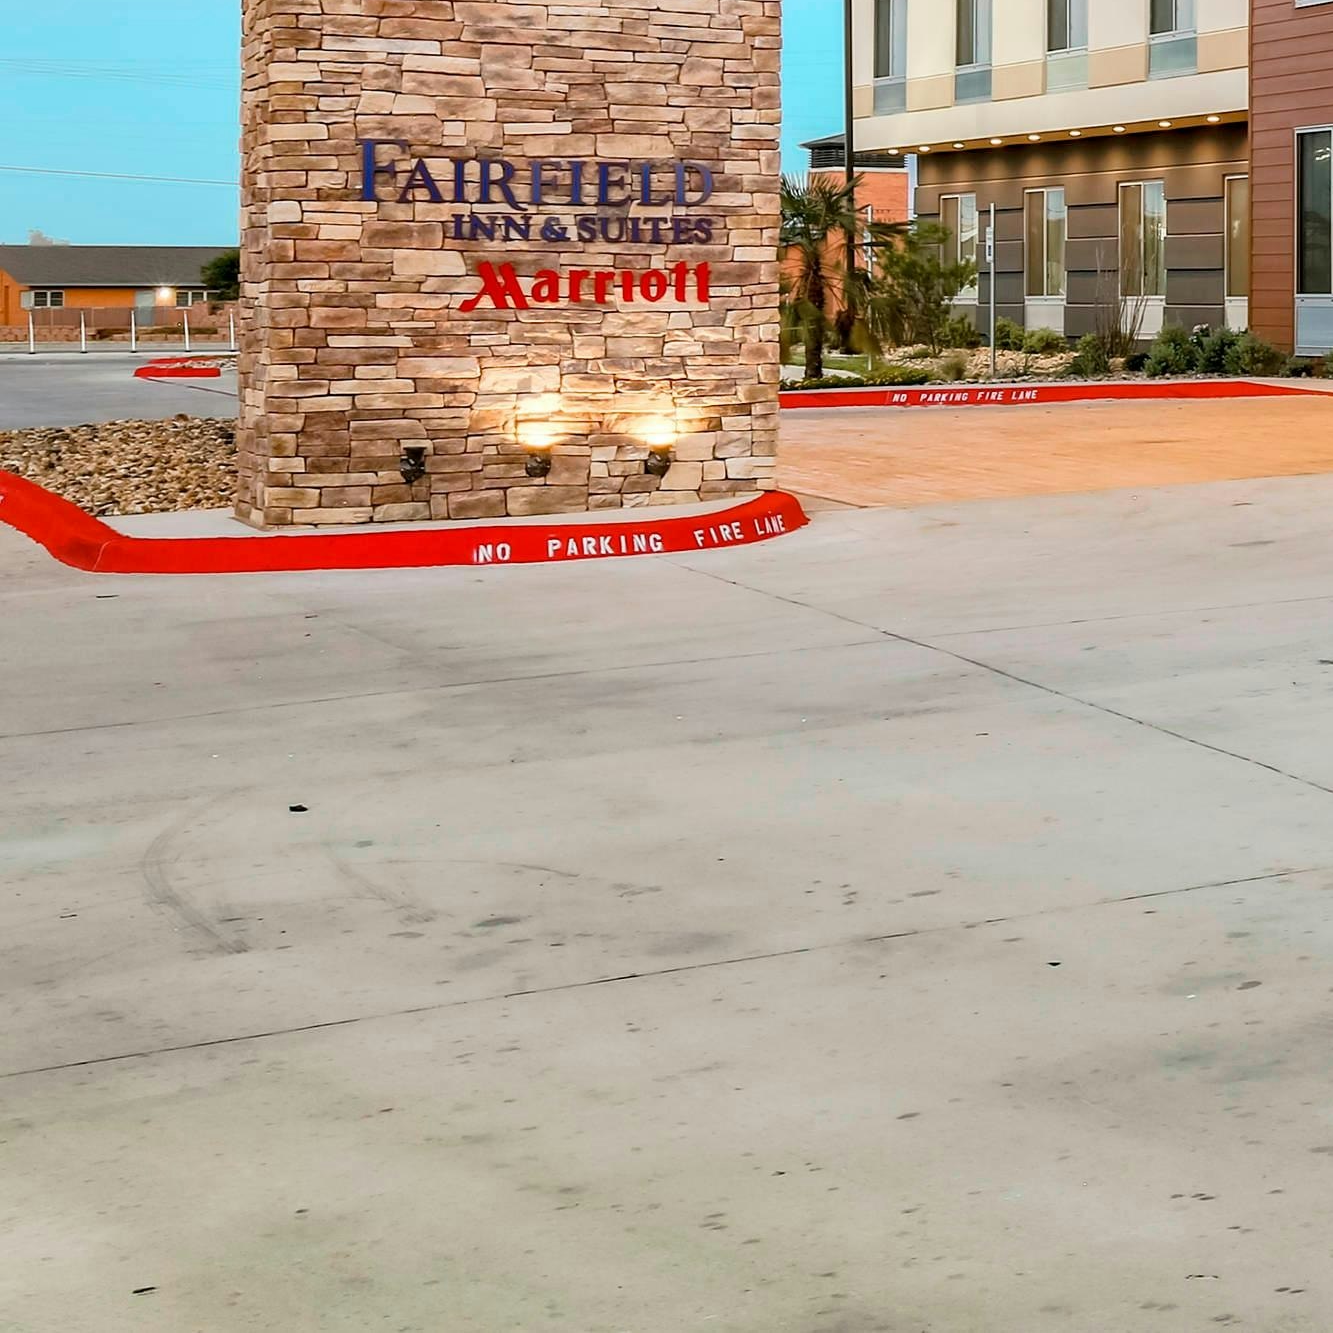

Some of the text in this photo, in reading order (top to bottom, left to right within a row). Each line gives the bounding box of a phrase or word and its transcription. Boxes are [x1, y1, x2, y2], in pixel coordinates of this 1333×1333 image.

[357, 138, 716, 212] FAIRFIELD
[452, 213, 713, 245] INN & SUITES
[458, 261, 712, 313] Marriott
[892, 389, 1038, 403] NO PARKING FIRE LANE
[473, 514, 787, 563] NO PARKING FIRE LANE
